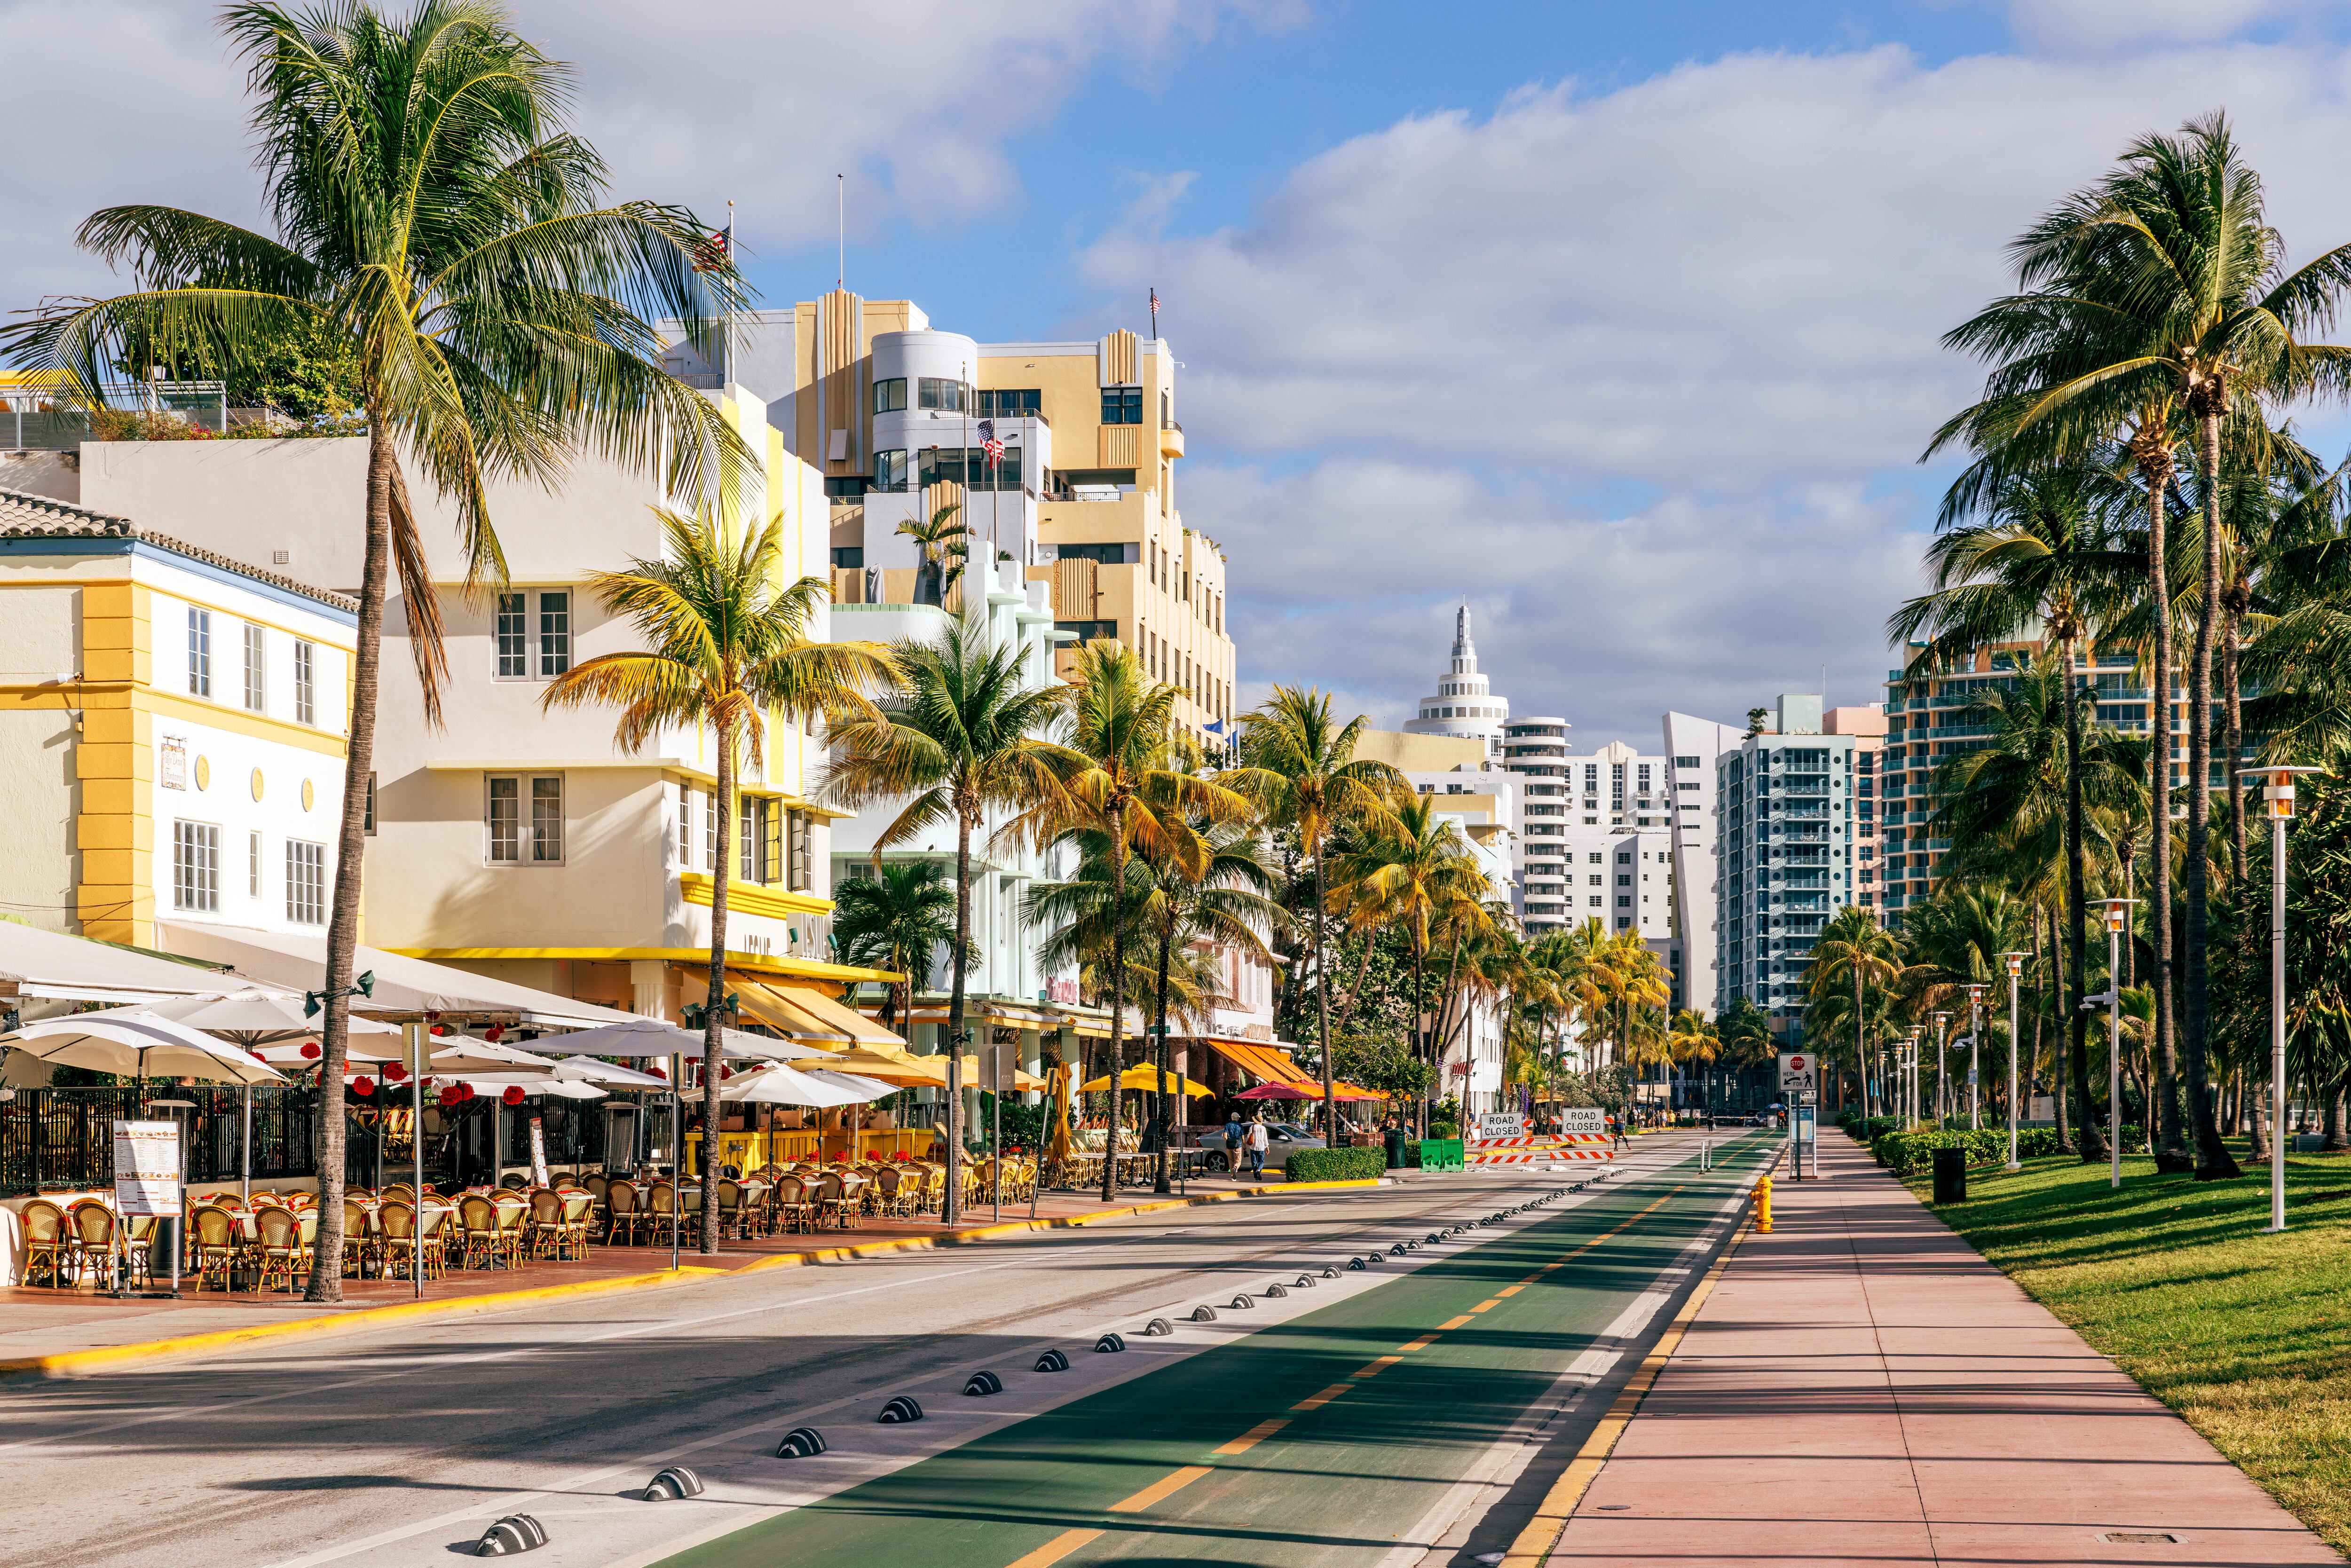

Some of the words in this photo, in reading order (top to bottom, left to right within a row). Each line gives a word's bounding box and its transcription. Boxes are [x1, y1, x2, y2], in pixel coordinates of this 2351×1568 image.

[802, 913, 828, 959] LESLIE
[1489, 1116, 1514, 1125] ROAD
[1485, 1127, 1519, 1135] CLOSED
